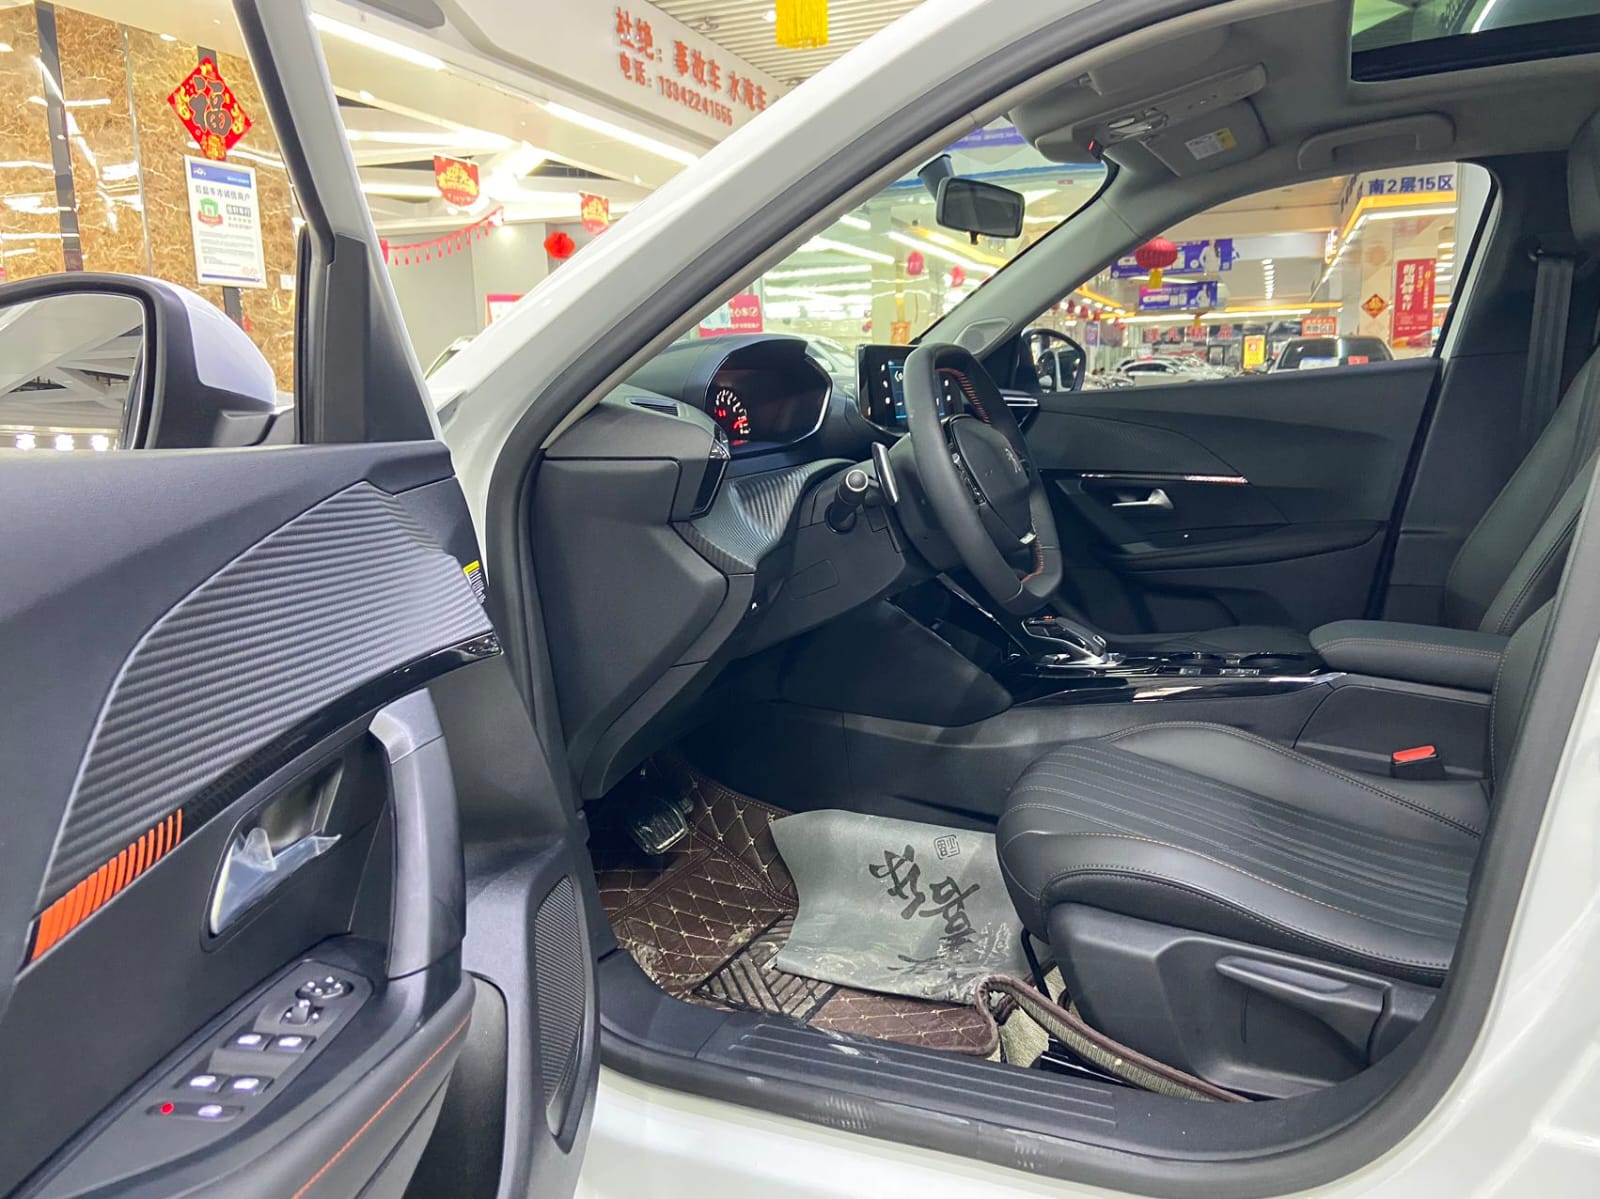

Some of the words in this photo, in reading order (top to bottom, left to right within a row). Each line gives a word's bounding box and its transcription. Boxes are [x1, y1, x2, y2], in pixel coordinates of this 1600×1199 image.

[674, 40, 721, 91] 事故车
[189, 75, 233, 137] 福
[1368, 174, 1454, 195] 南2层15区
